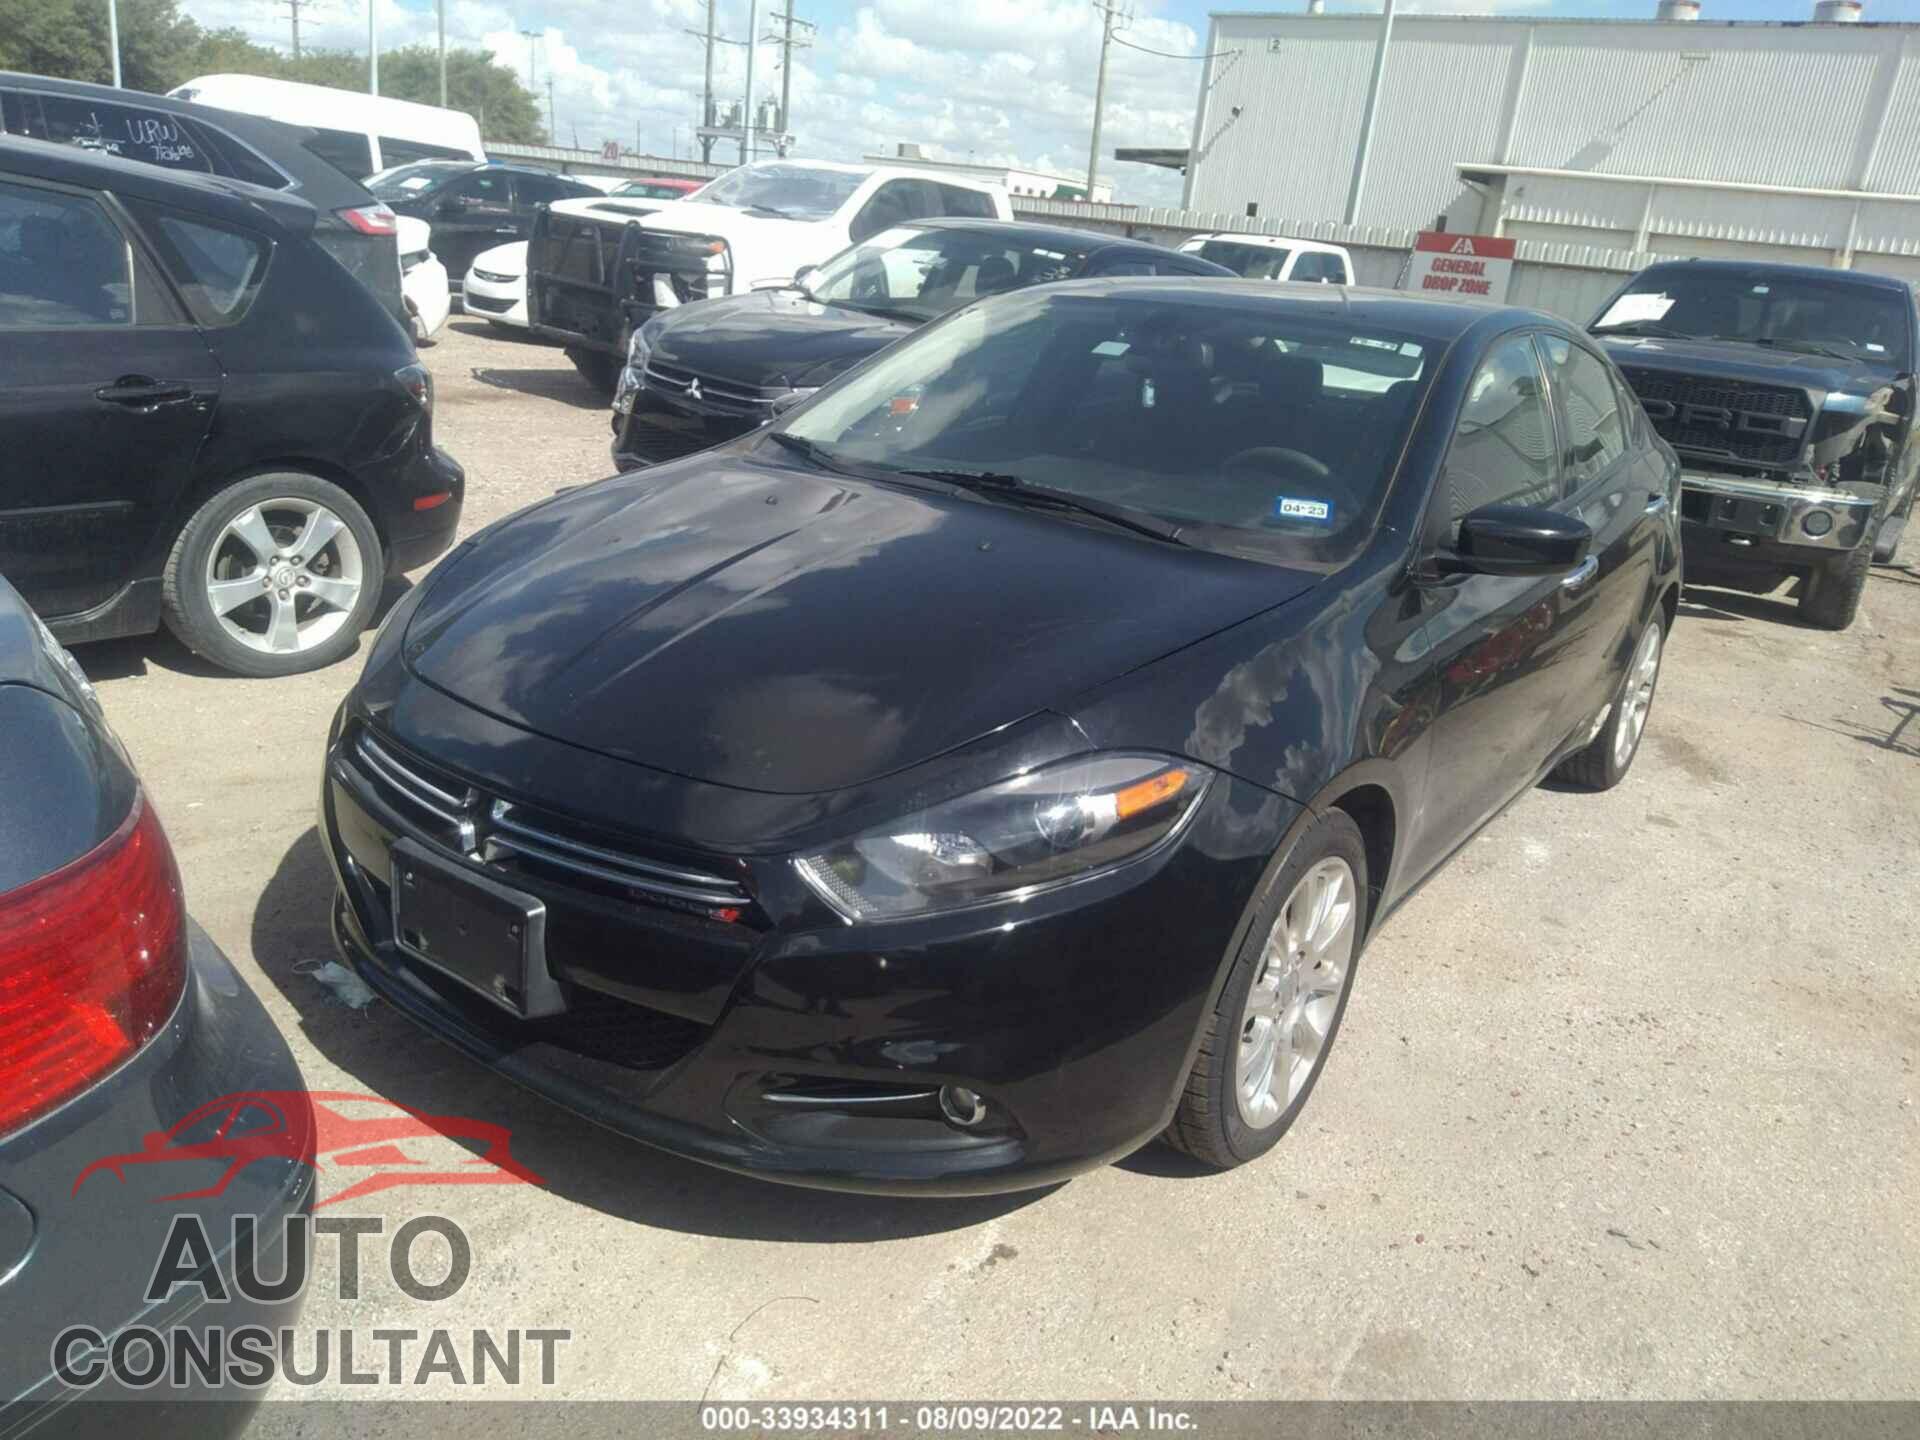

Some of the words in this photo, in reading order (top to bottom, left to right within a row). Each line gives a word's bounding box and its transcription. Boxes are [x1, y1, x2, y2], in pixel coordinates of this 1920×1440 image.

[1430, 257, 1487, 277] GENERAL
[1421, 274, 1459, 293] DROP
[1457, 277, 1493, 296] ZONE
